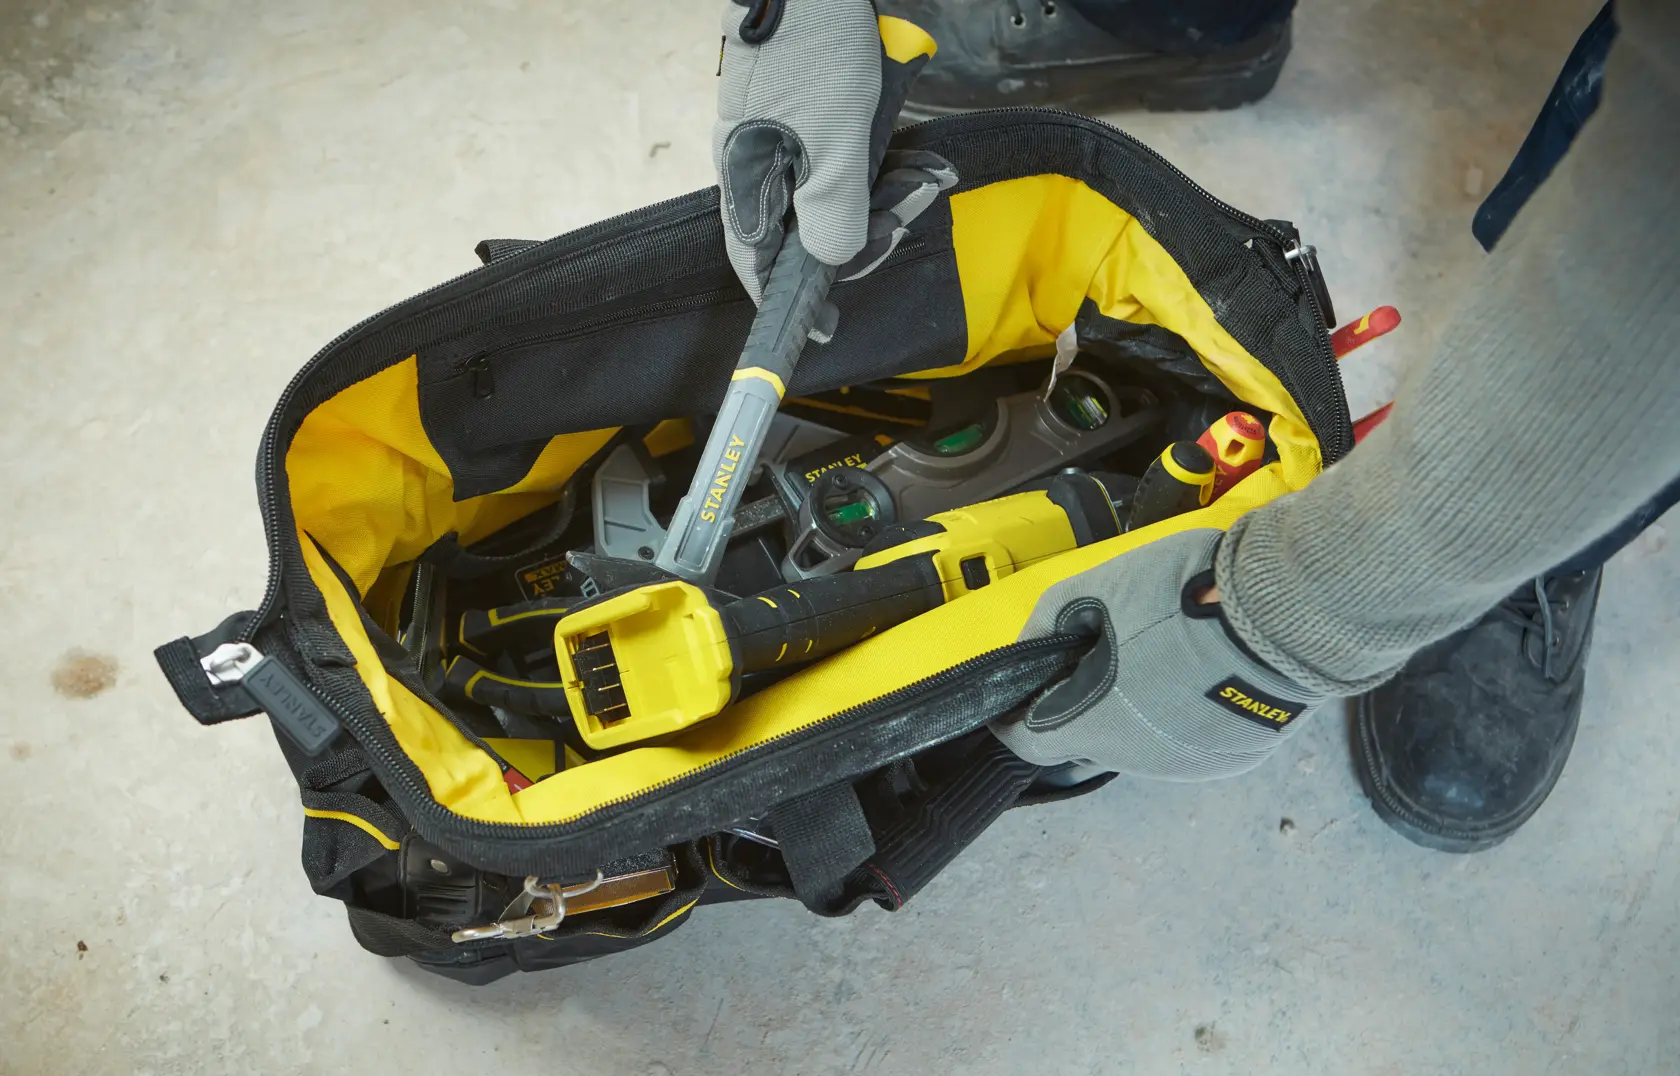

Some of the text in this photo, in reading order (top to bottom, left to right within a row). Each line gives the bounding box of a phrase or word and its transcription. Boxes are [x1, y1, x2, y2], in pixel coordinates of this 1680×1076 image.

[701, 434, 745, 524] STANLEY
[260, 673, 327, 738] STANLEY
[1219, 686, 1292, 722] STANLEY
